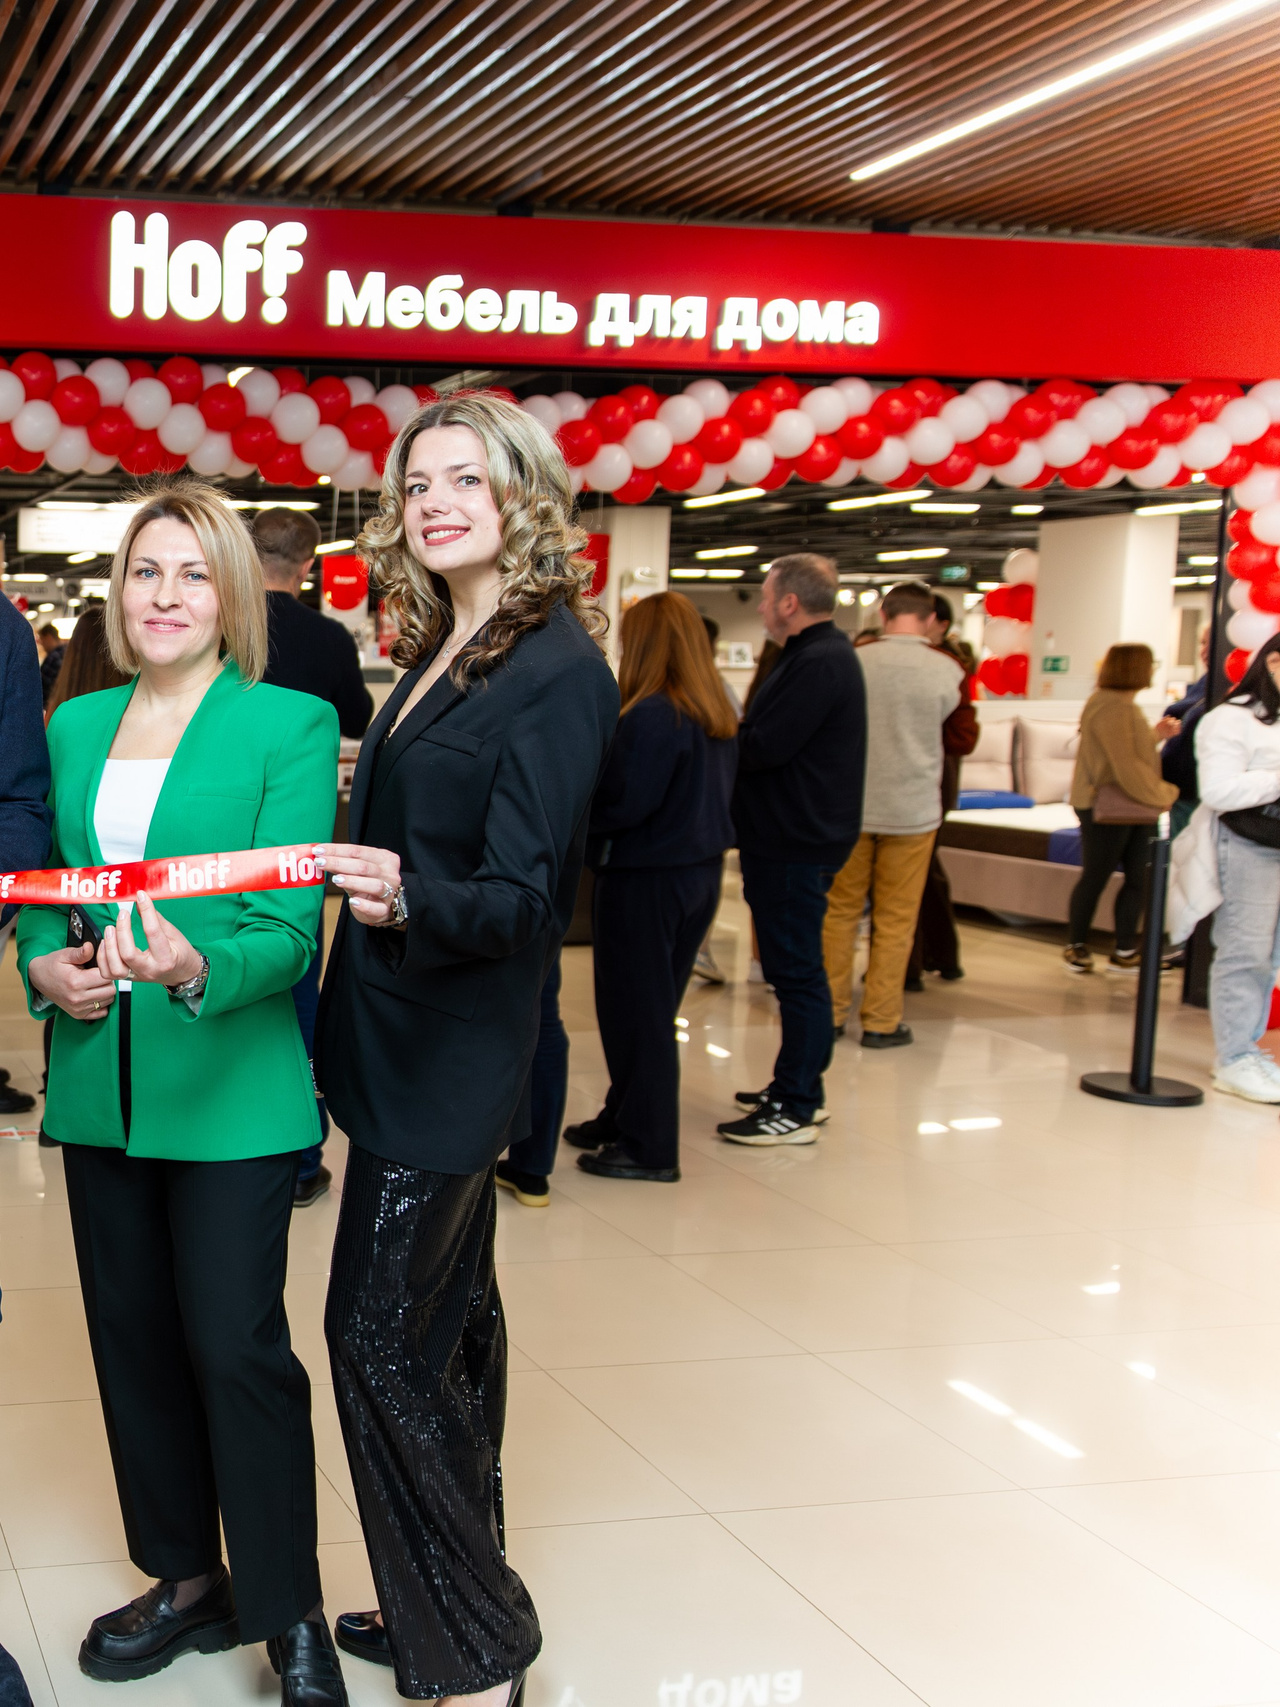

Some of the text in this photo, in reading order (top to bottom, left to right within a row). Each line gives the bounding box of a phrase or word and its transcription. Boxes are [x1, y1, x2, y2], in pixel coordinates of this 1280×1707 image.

[327, 269, 881, 351] Мебель для дома
